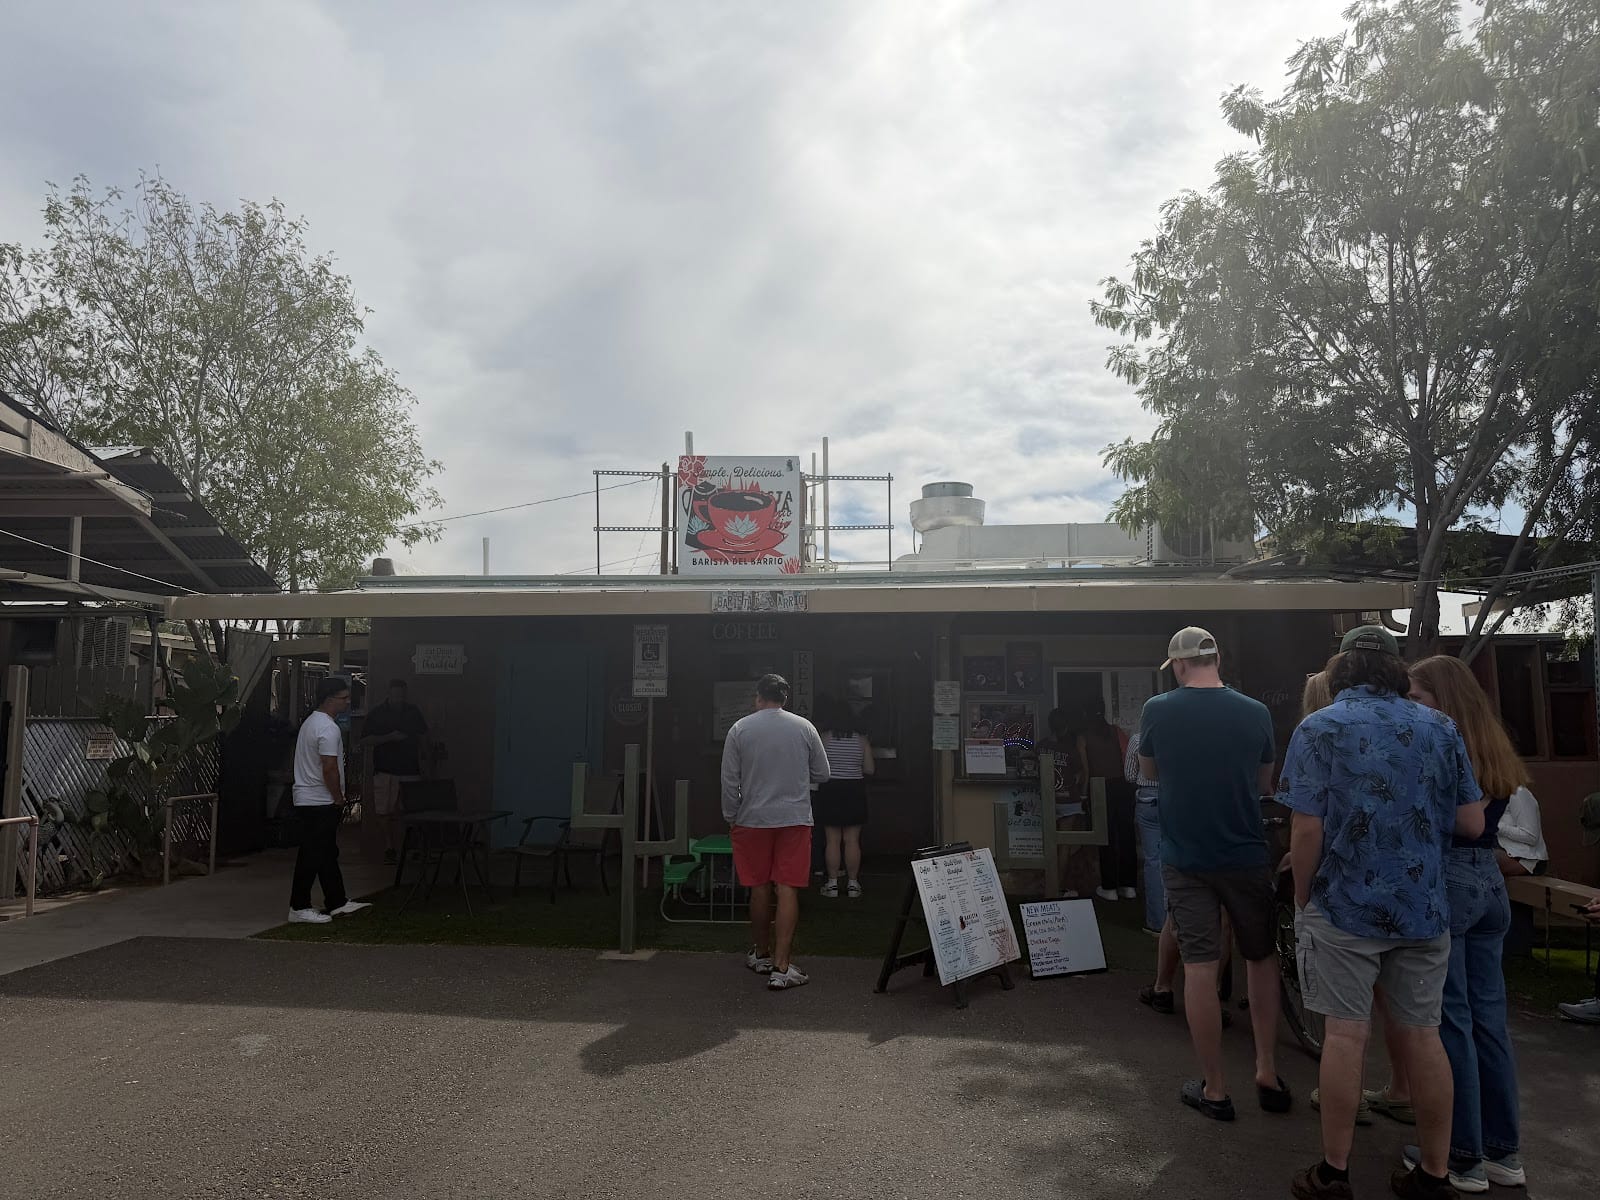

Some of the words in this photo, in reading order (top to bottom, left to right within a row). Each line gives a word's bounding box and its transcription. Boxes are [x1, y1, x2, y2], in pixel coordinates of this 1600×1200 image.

[692, 558, 729, 566] BARISTA
[732, 557, 748, 565] DEL
[751, 557, 783, 565] BARRIO
[713, 623, 777, 640] COFFEE
[1026, 905, 1040, 915] NEW
[1040, 903, 1061, 913] MEATS
